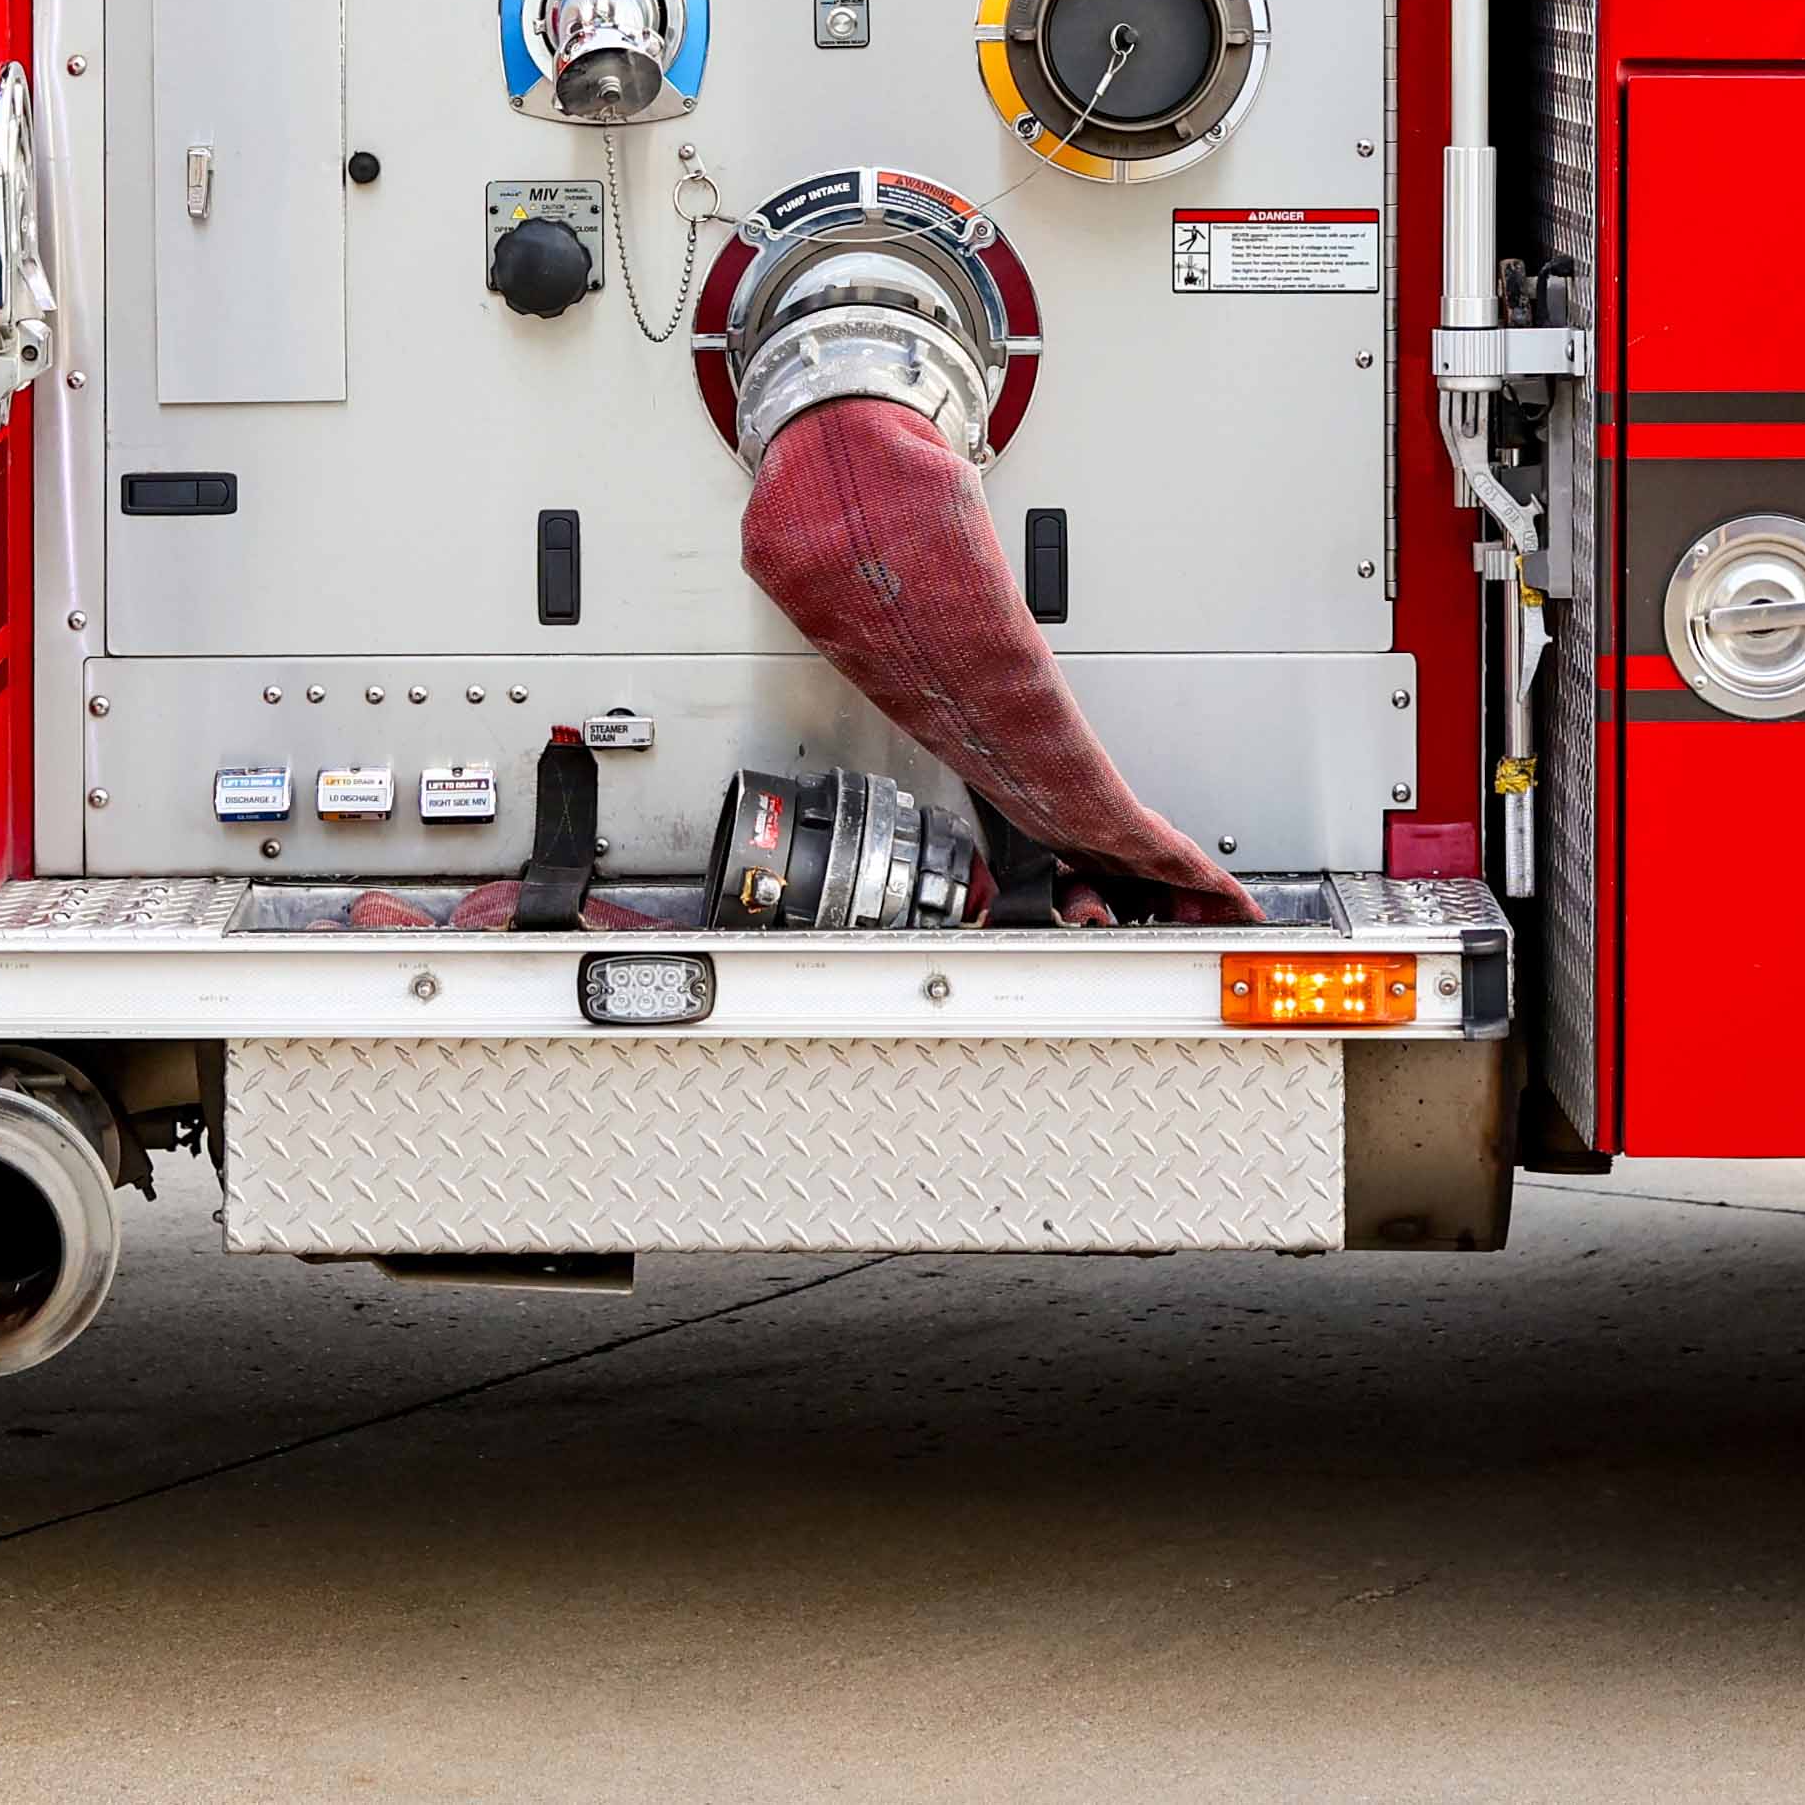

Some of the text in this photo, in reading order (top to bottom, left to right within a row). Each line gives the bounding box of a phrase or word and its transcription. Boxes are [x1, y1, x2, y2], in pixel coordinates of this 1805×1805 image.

[529, 188, 559, 201] MIV
[903, 175, 955, 206] WARNING
[775, 182, 851, 217] PUMP INTAKE
[1258, 212, 1305, 221] DANGER
[590, 724, 628, 734] STEAMER
[590, 734, 615, 742] DRAIN
[444, 782, 454, 790] TO
[225, 795, 269, 804] DISCHARGE
[340, 795, 380, 803] DISCHARGE
[428, 797, 487, 808] RIGHT SIDE MIV
